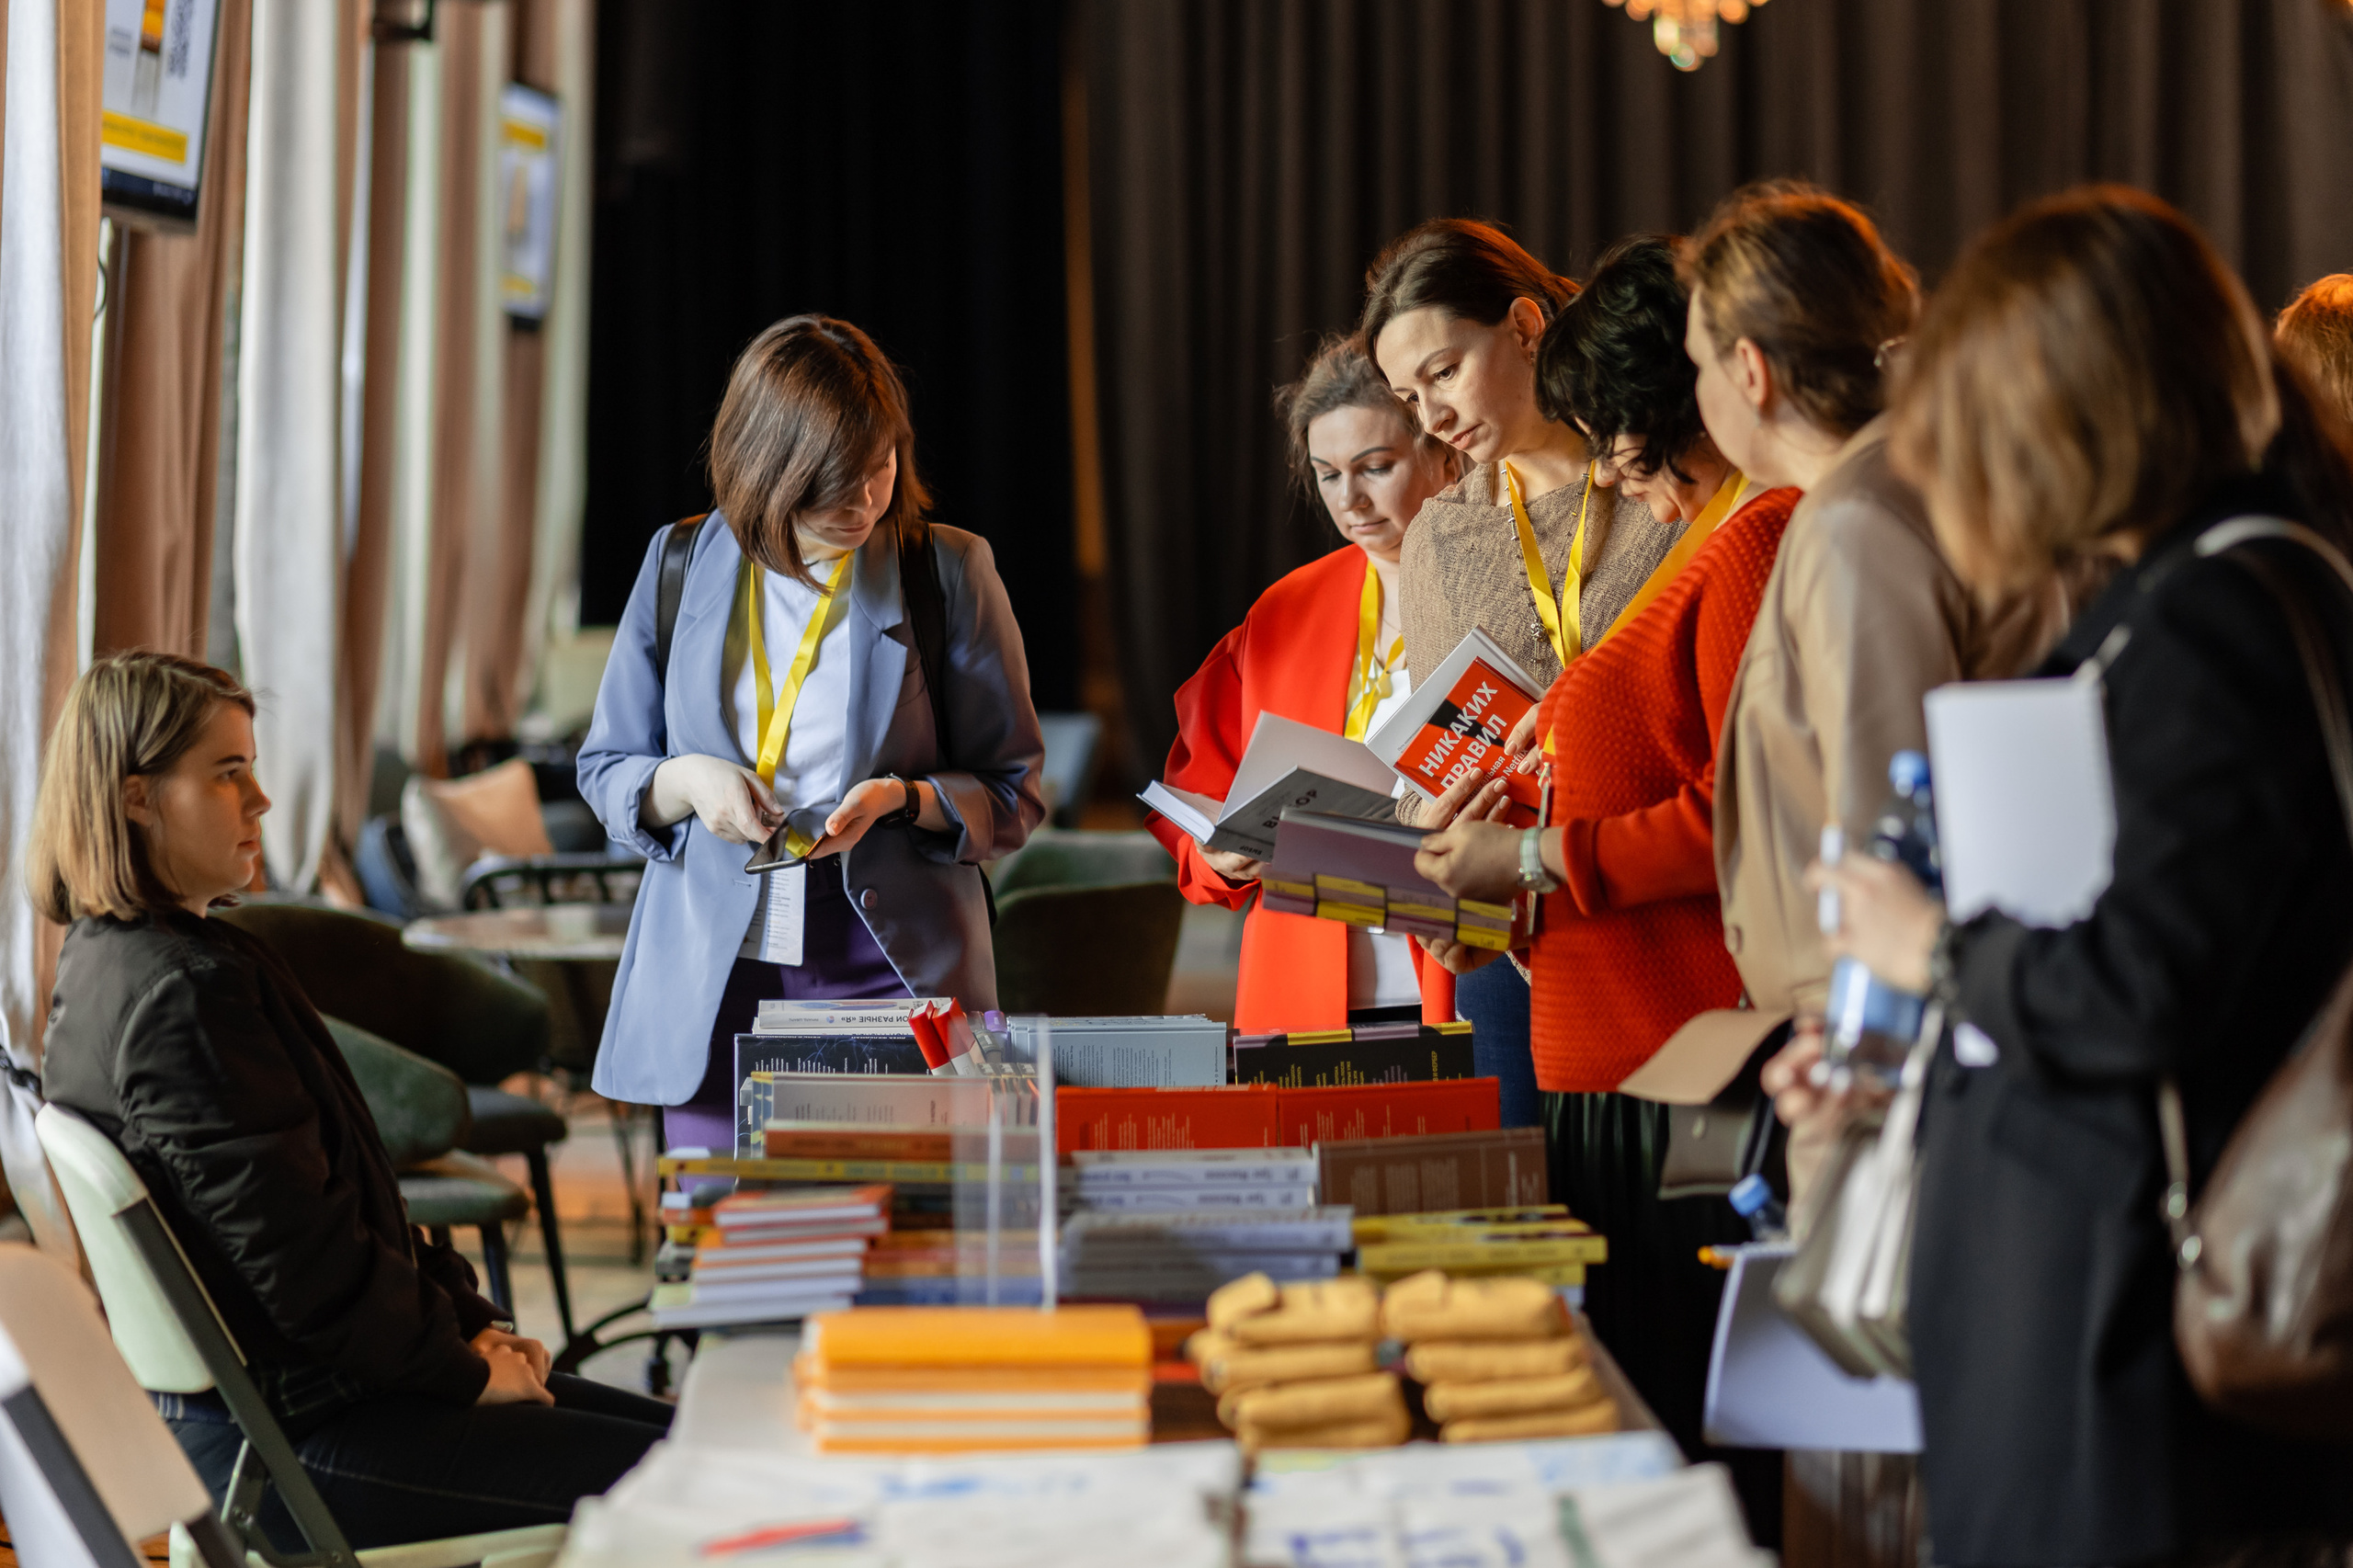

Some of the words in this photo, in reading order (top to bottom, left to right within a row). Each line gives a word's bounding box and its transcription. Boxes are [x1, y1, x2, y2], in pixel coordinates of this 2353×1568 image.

[1418, 681, 1498, 778] НИКАКИХ
[1440, 713, 1507, 790] ПРАВИЛ
[1503, 747, 1529, 777] Netflix
[1263, 790, 1317, 829] ВОР
